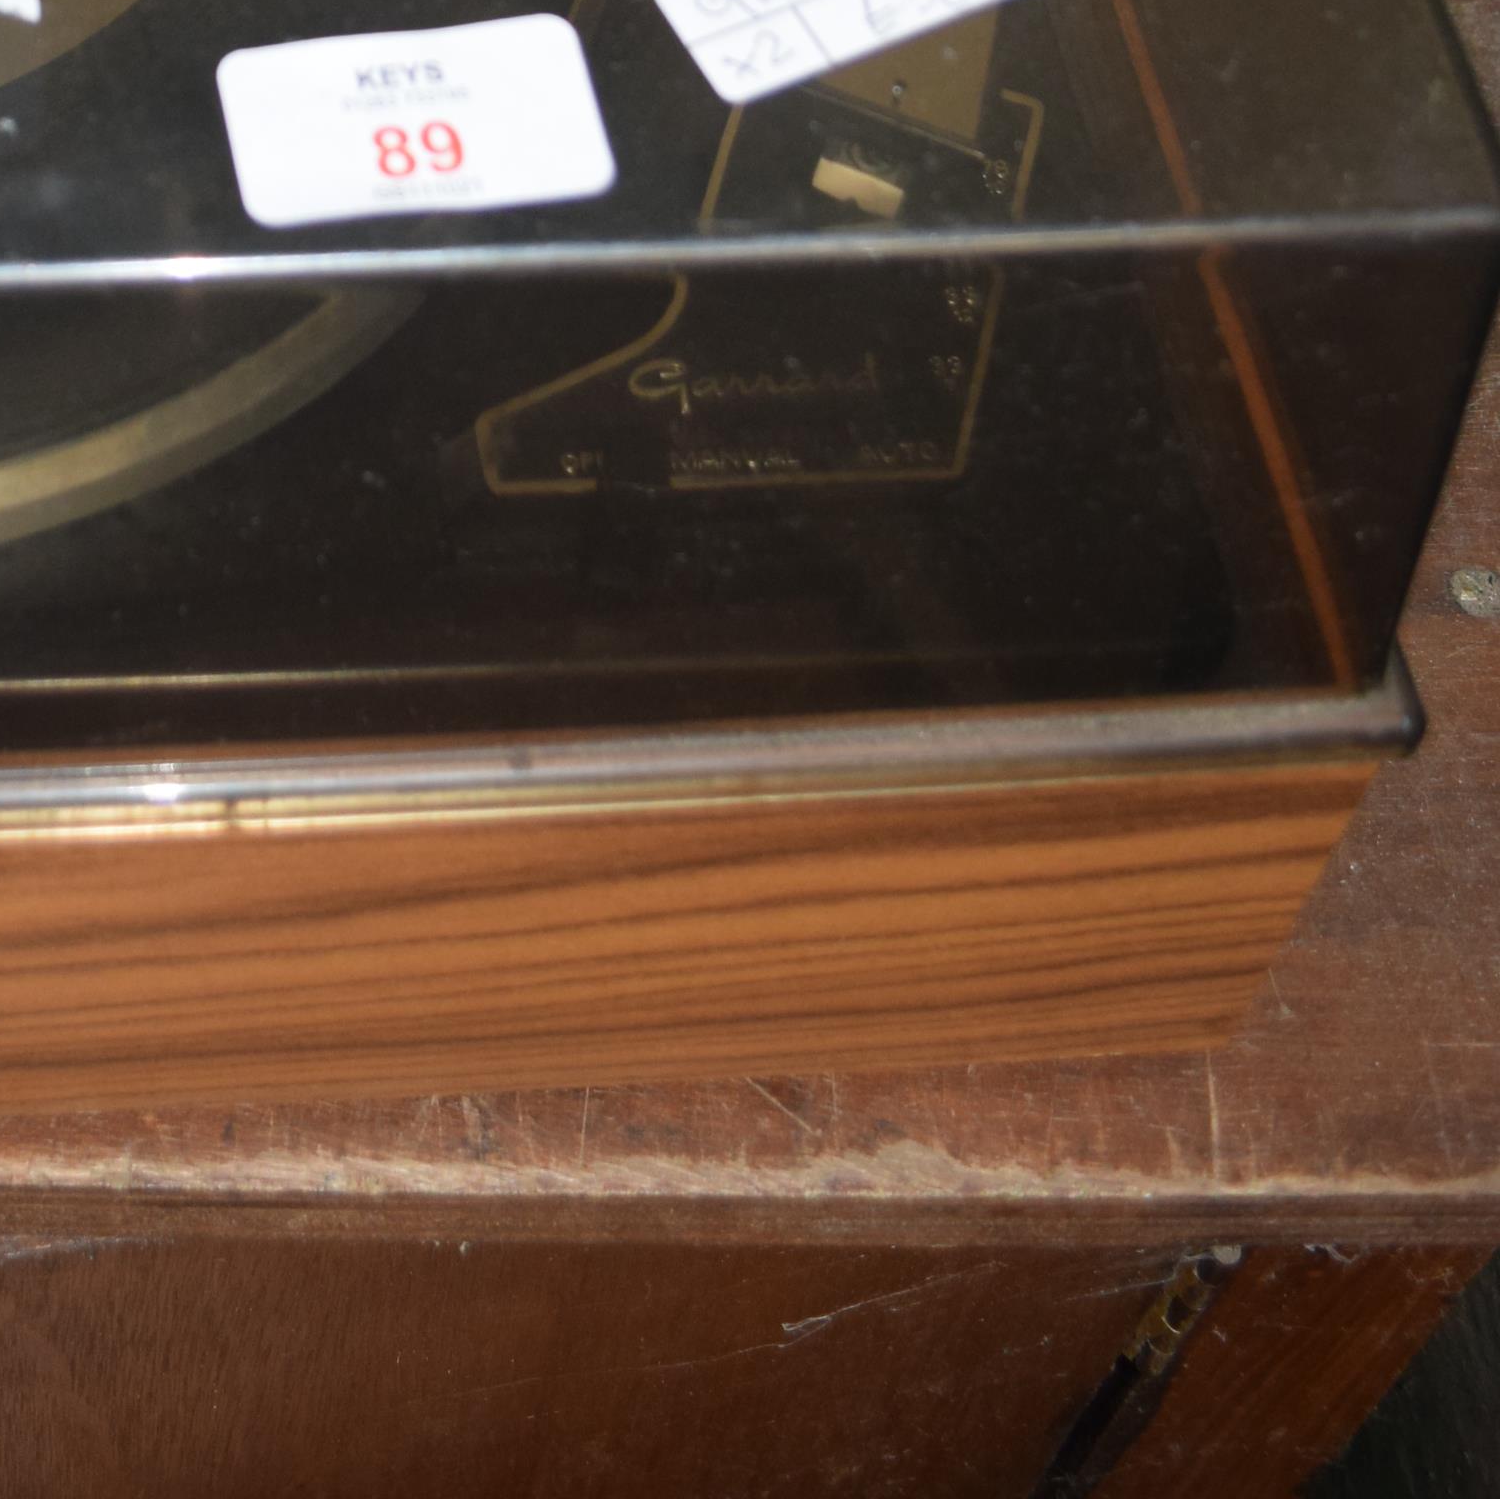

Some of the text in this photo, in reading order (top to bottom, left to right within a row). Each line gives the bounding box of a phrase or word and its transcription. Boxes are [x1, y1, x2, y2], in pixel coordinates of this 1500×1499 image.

[354, 59, 445, 90] KEYS
[373, 121, 465, 179] 89
[629, 352, 880, 416] Garrard
